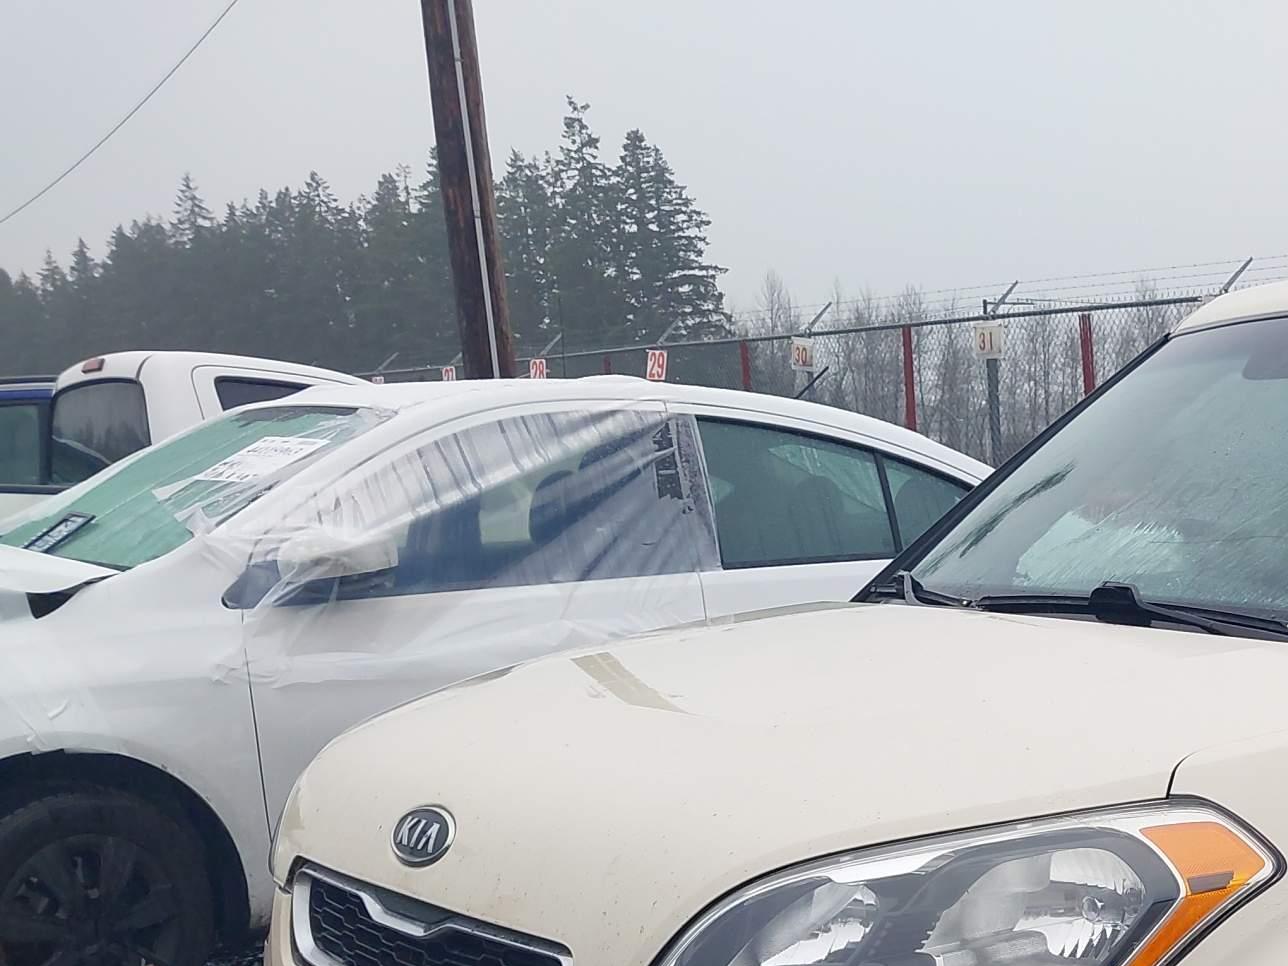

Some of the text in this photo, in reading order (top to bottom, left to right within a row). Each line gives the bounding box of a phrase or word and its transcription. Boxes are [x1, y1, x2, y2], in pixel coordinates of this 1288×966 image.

[979, 331, 993, 351] 31
[648, 351, 665, 379] 29
[795, 346, 808, 364] 30
[396, 815, 441, 854] KIA
